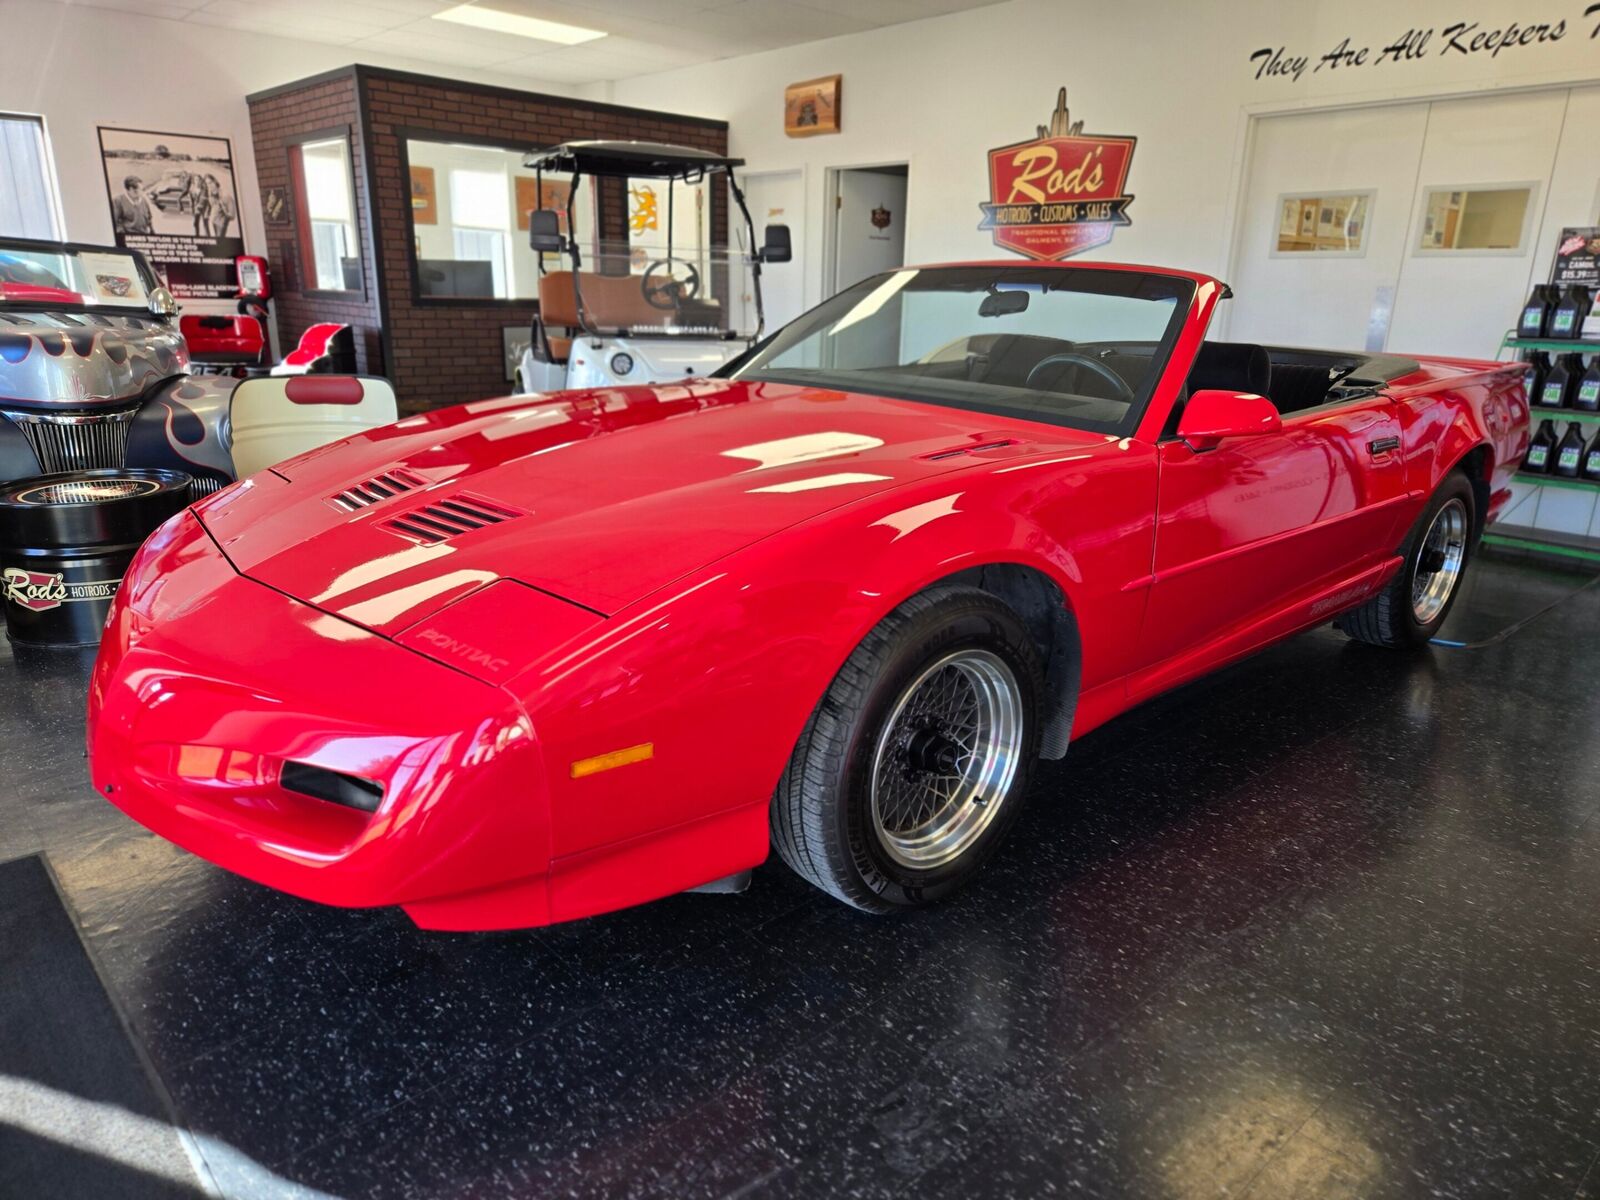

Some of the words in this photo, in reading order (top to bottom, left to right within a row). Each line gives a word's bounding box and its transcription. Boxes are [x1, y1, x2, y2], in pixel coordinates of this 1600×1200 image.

[1250, 47, 1309, 82] They
[1313, 38, 1369, 73] Are
[1374, 28, 1434, 66] All
[1441, 19, 1567, 58] Keepers
[1007, 145, 1104, 205] Rod's
[996, 206, 1032, 223] HOTRODS
[1040, 205, 1078, 222] CUSTOMS
[1086, 203, 1112, 220] SALES
[147, 235, 172, 243] TAYLOR
[4, 568, 68, 604] Rod's
[71, 584, 111, 598] HOTRODS
[416, 628, 510, 672] PONTIAC
